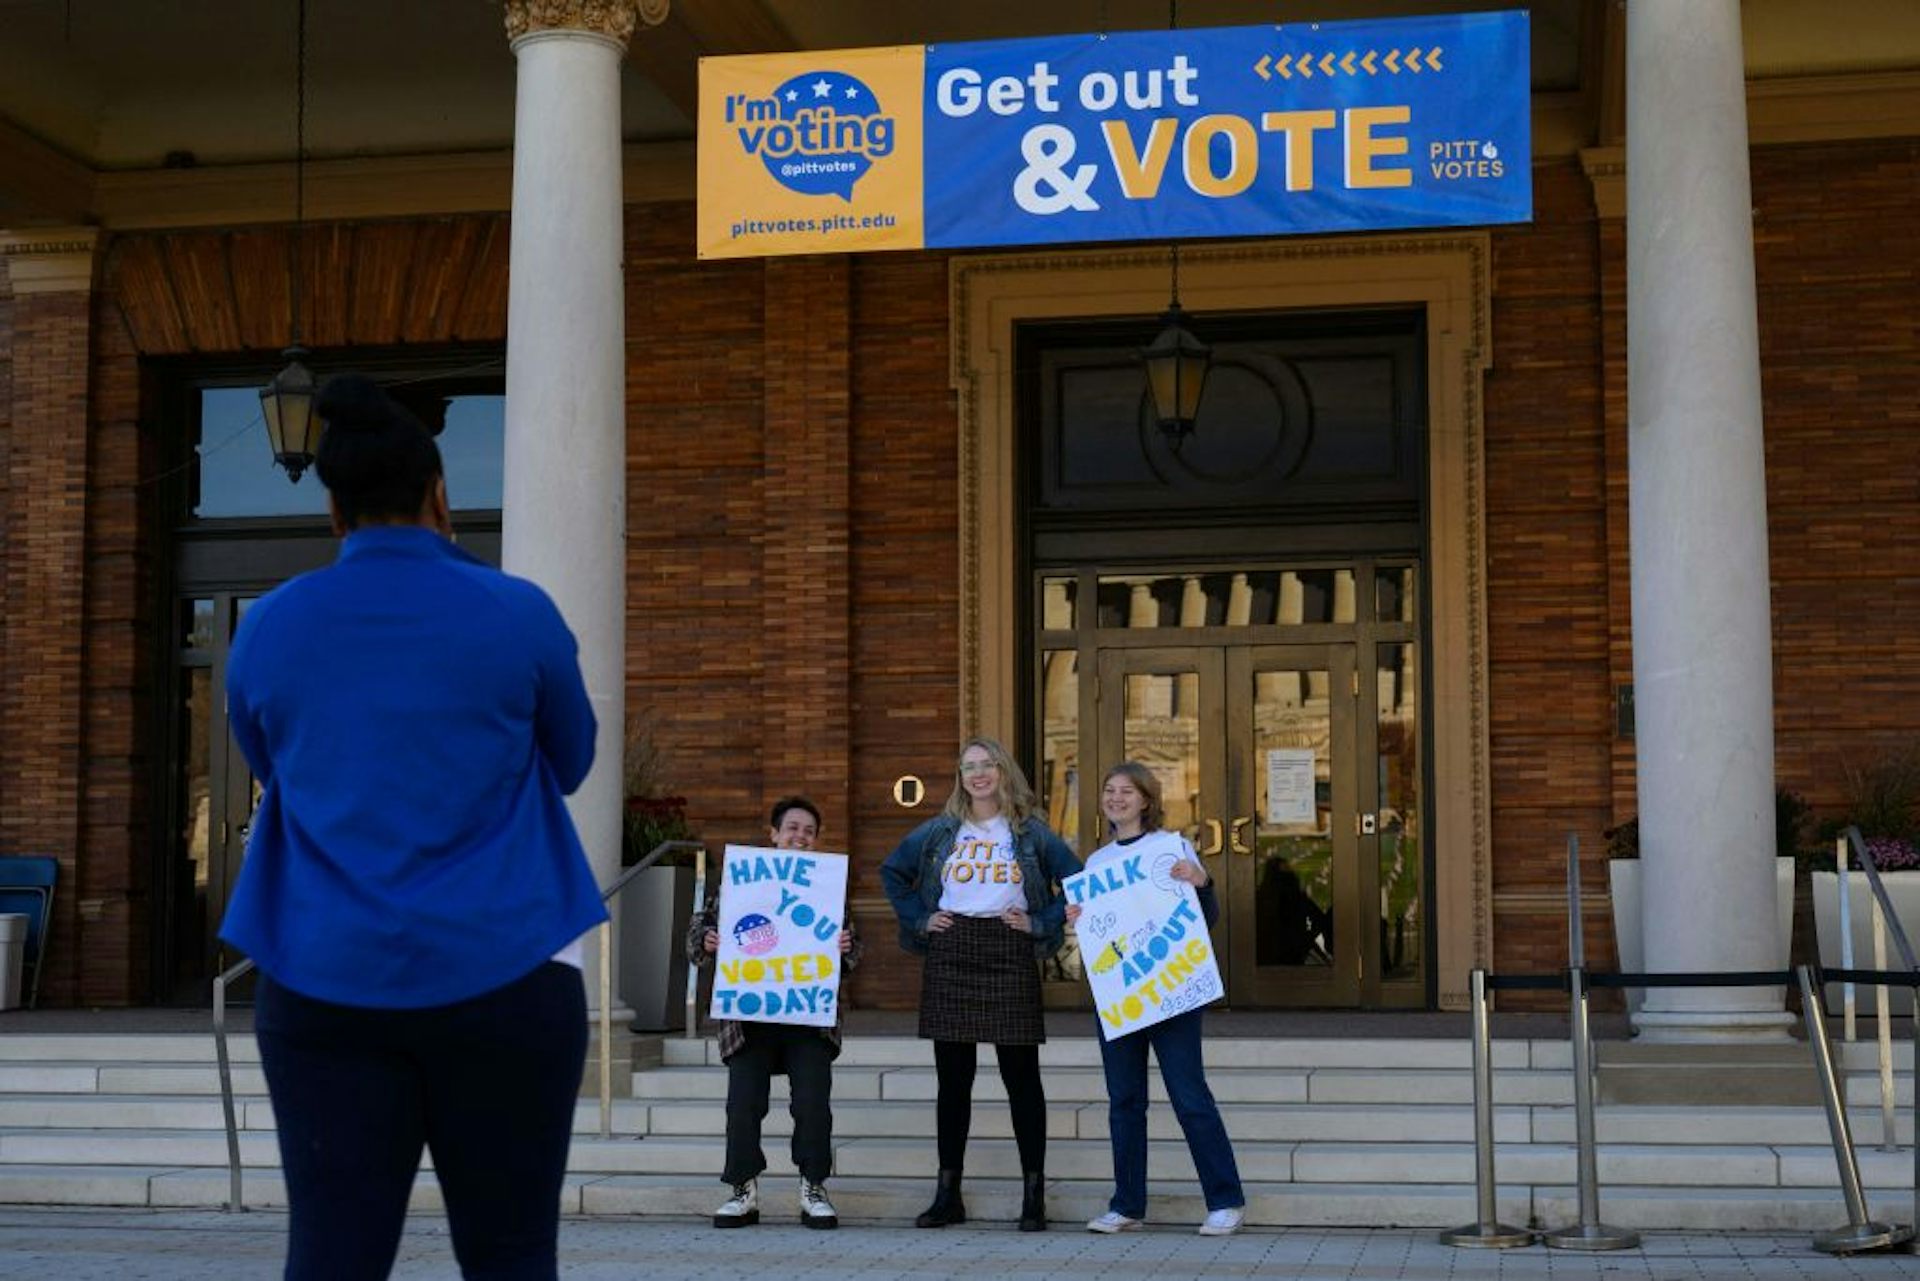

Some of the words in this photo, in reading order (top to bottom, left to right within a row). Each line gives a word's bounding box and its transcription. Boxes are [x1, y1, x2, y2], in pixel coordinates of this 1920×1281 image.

[936, 62, 1059, 118] Get
[1079, 55, 1200, 113] out
[725, 93, 778, 123] I'm
[738, 110, 895, 157] voting
[1430, 140, 1479, 159] PITT
[781, 161, 857, 177] @pittvotes
[1431, 160, 1504, 179] VOTES
[732, 213, 896, 240] pittvotes.pitt.edu
[729, 856, 816, 887] HAVE
[1067, 855, 1146, 904] TALK
[775, 888, 838, 941] YOU
[1121, 899, 1198, 989] ABOUT
[720, 953, 834, 984] VOTED
[1100, 938, 1208, 1029] VOTING
[716, 985, 834, 1016] TODAY?
